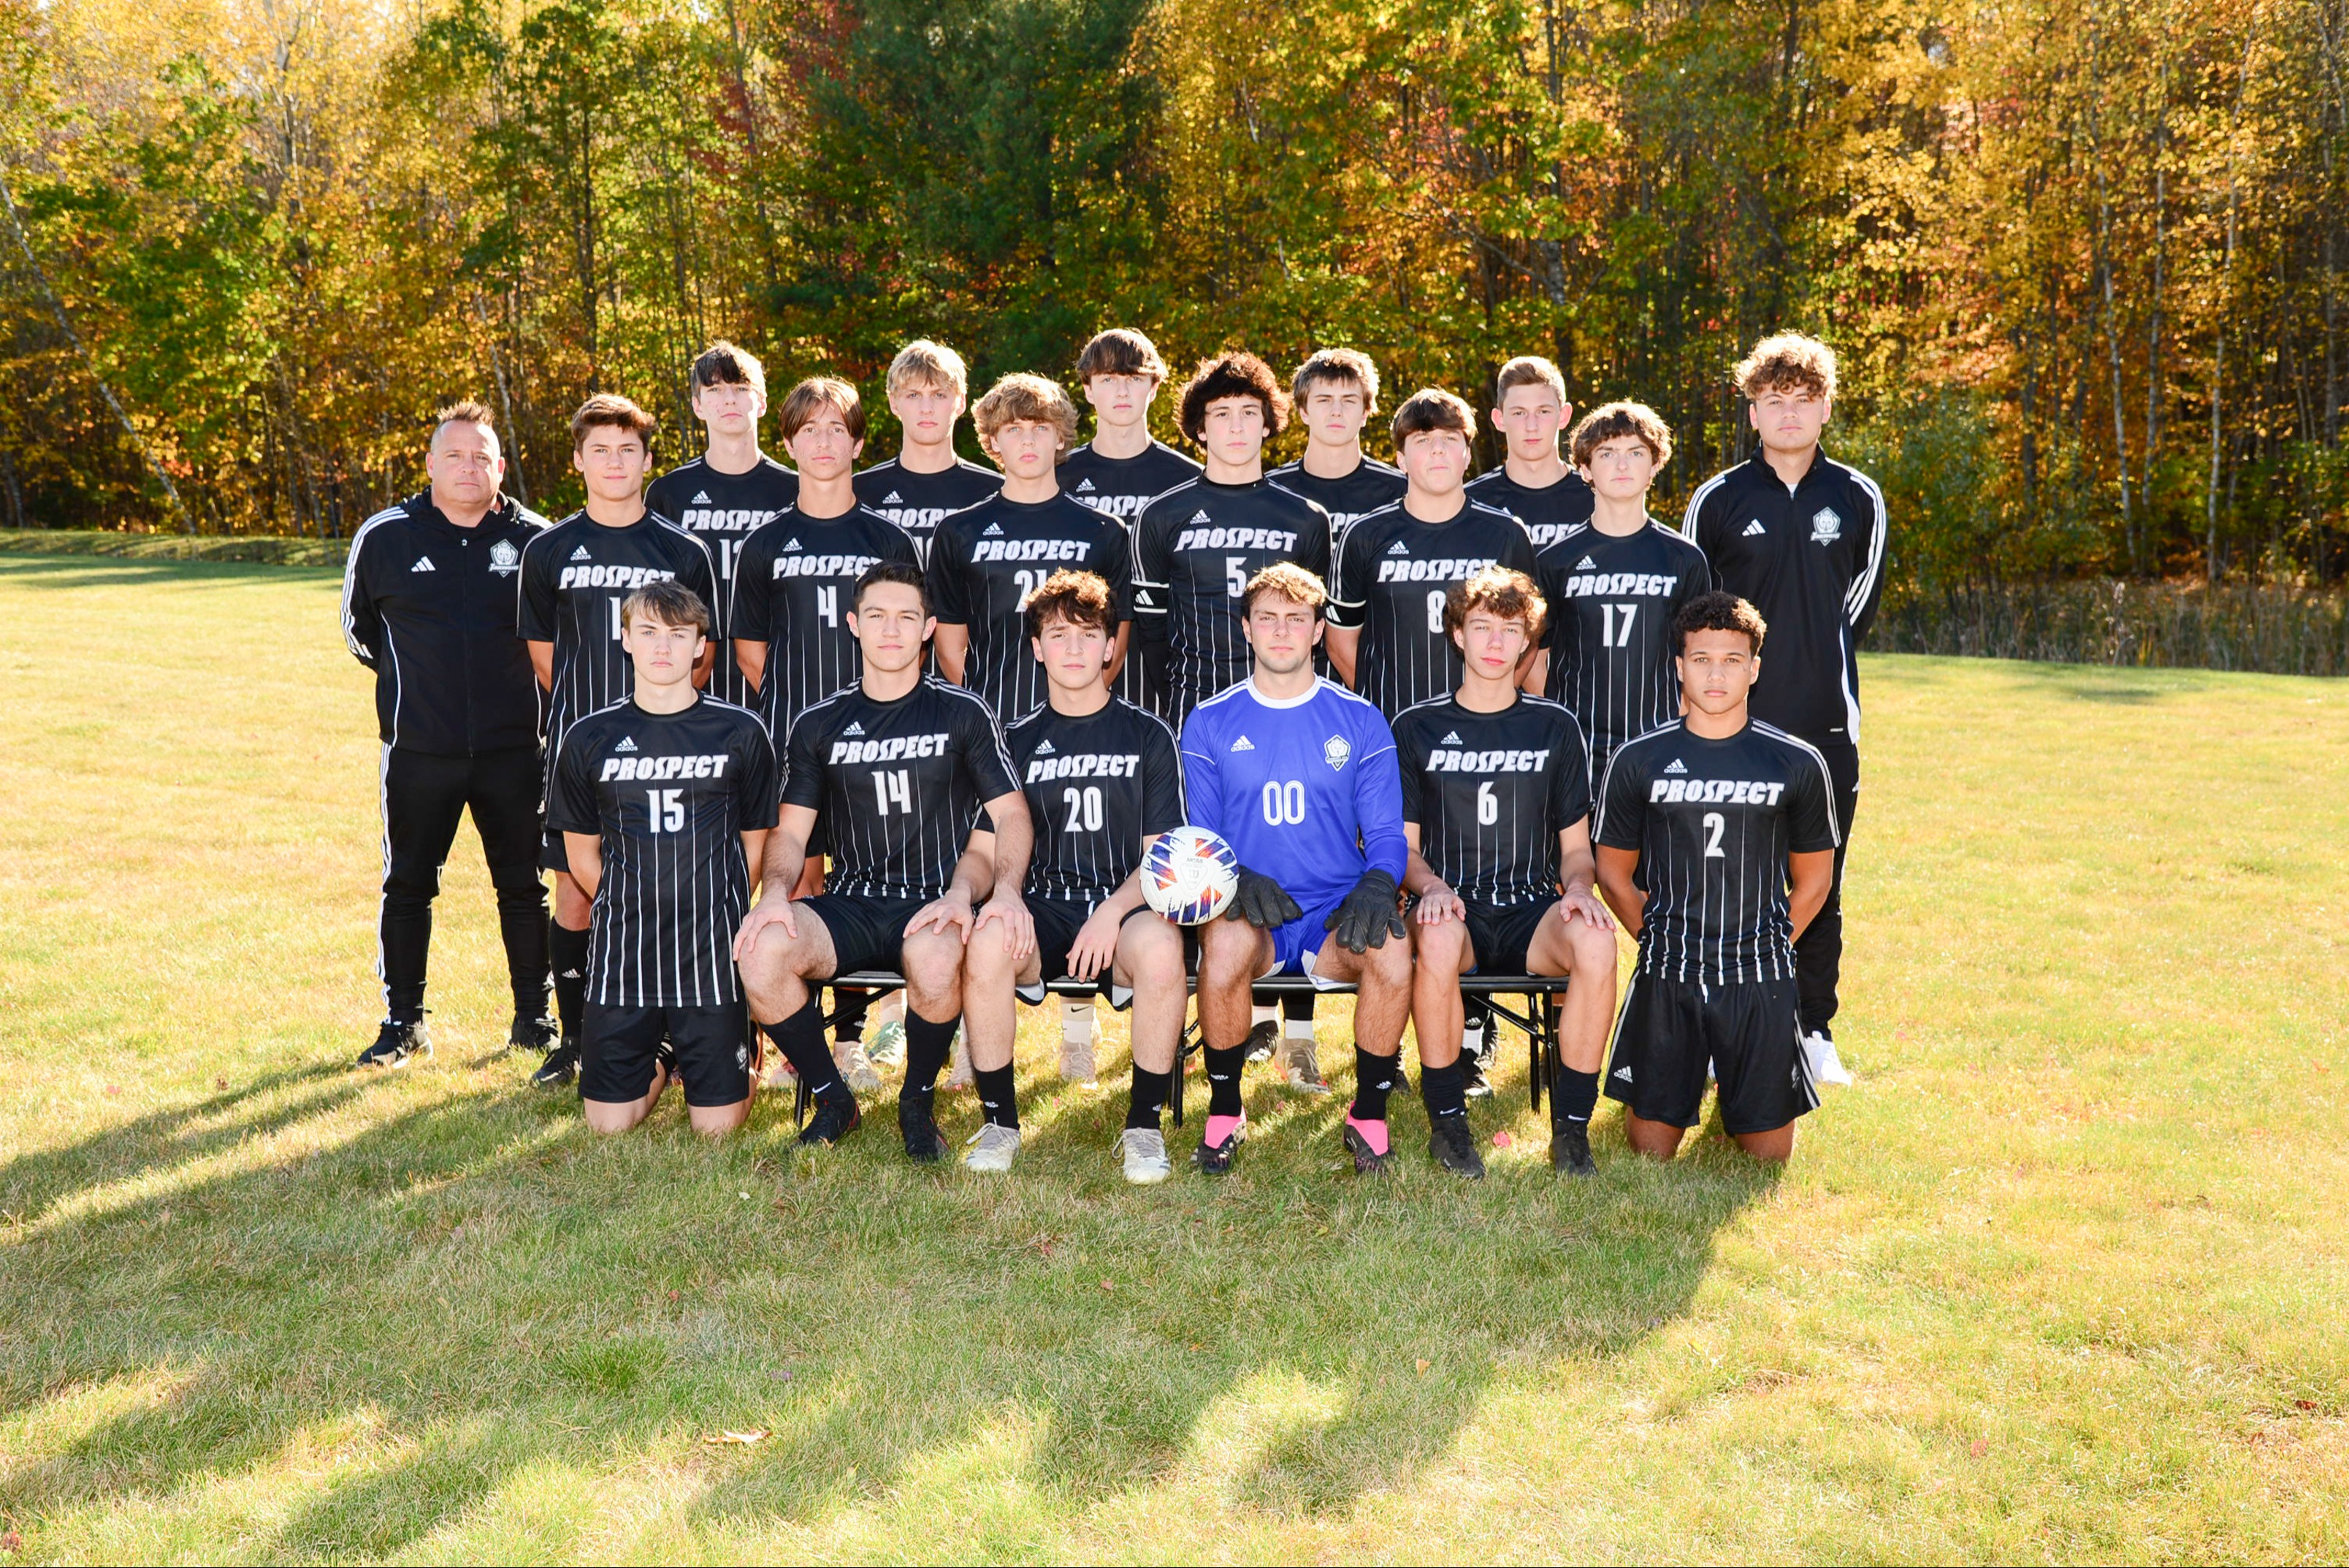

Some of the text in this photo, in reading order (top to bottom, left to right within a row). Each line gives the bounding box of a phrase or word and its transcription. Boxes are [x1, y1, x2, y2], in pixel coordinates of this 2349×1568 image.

[971, 540, 1091, 563] PROSPECT
[1173, 527, 1298, 552] PROSPECT
[1226, 557, 1247, 598] 5
[1565, 573, 1678, 598] PROSPECT
[817, 585, 838, 628] 4
[1426, 590, 1447, 634] 8
[1600, 604, 1638, 647] 17
[598, 754, 729, 782] PROSPECT
[828, 733, 950, 765] PROSPECT
[1025, 754, 1140, 784] PROSPECT
[1425, 749, 1550, 773] PROSPECT
[645, 788, 685, 833] 15
[871, 769, 912, 816] 14
[1063, 786, 1104, 833] 20
[1262, 780, 1306, 827] 00
[1477, 781, 1498, 826] 6
[1649, 779, 1785, 806] PROSPECT
[1703, 812, 1726, 858] 2
